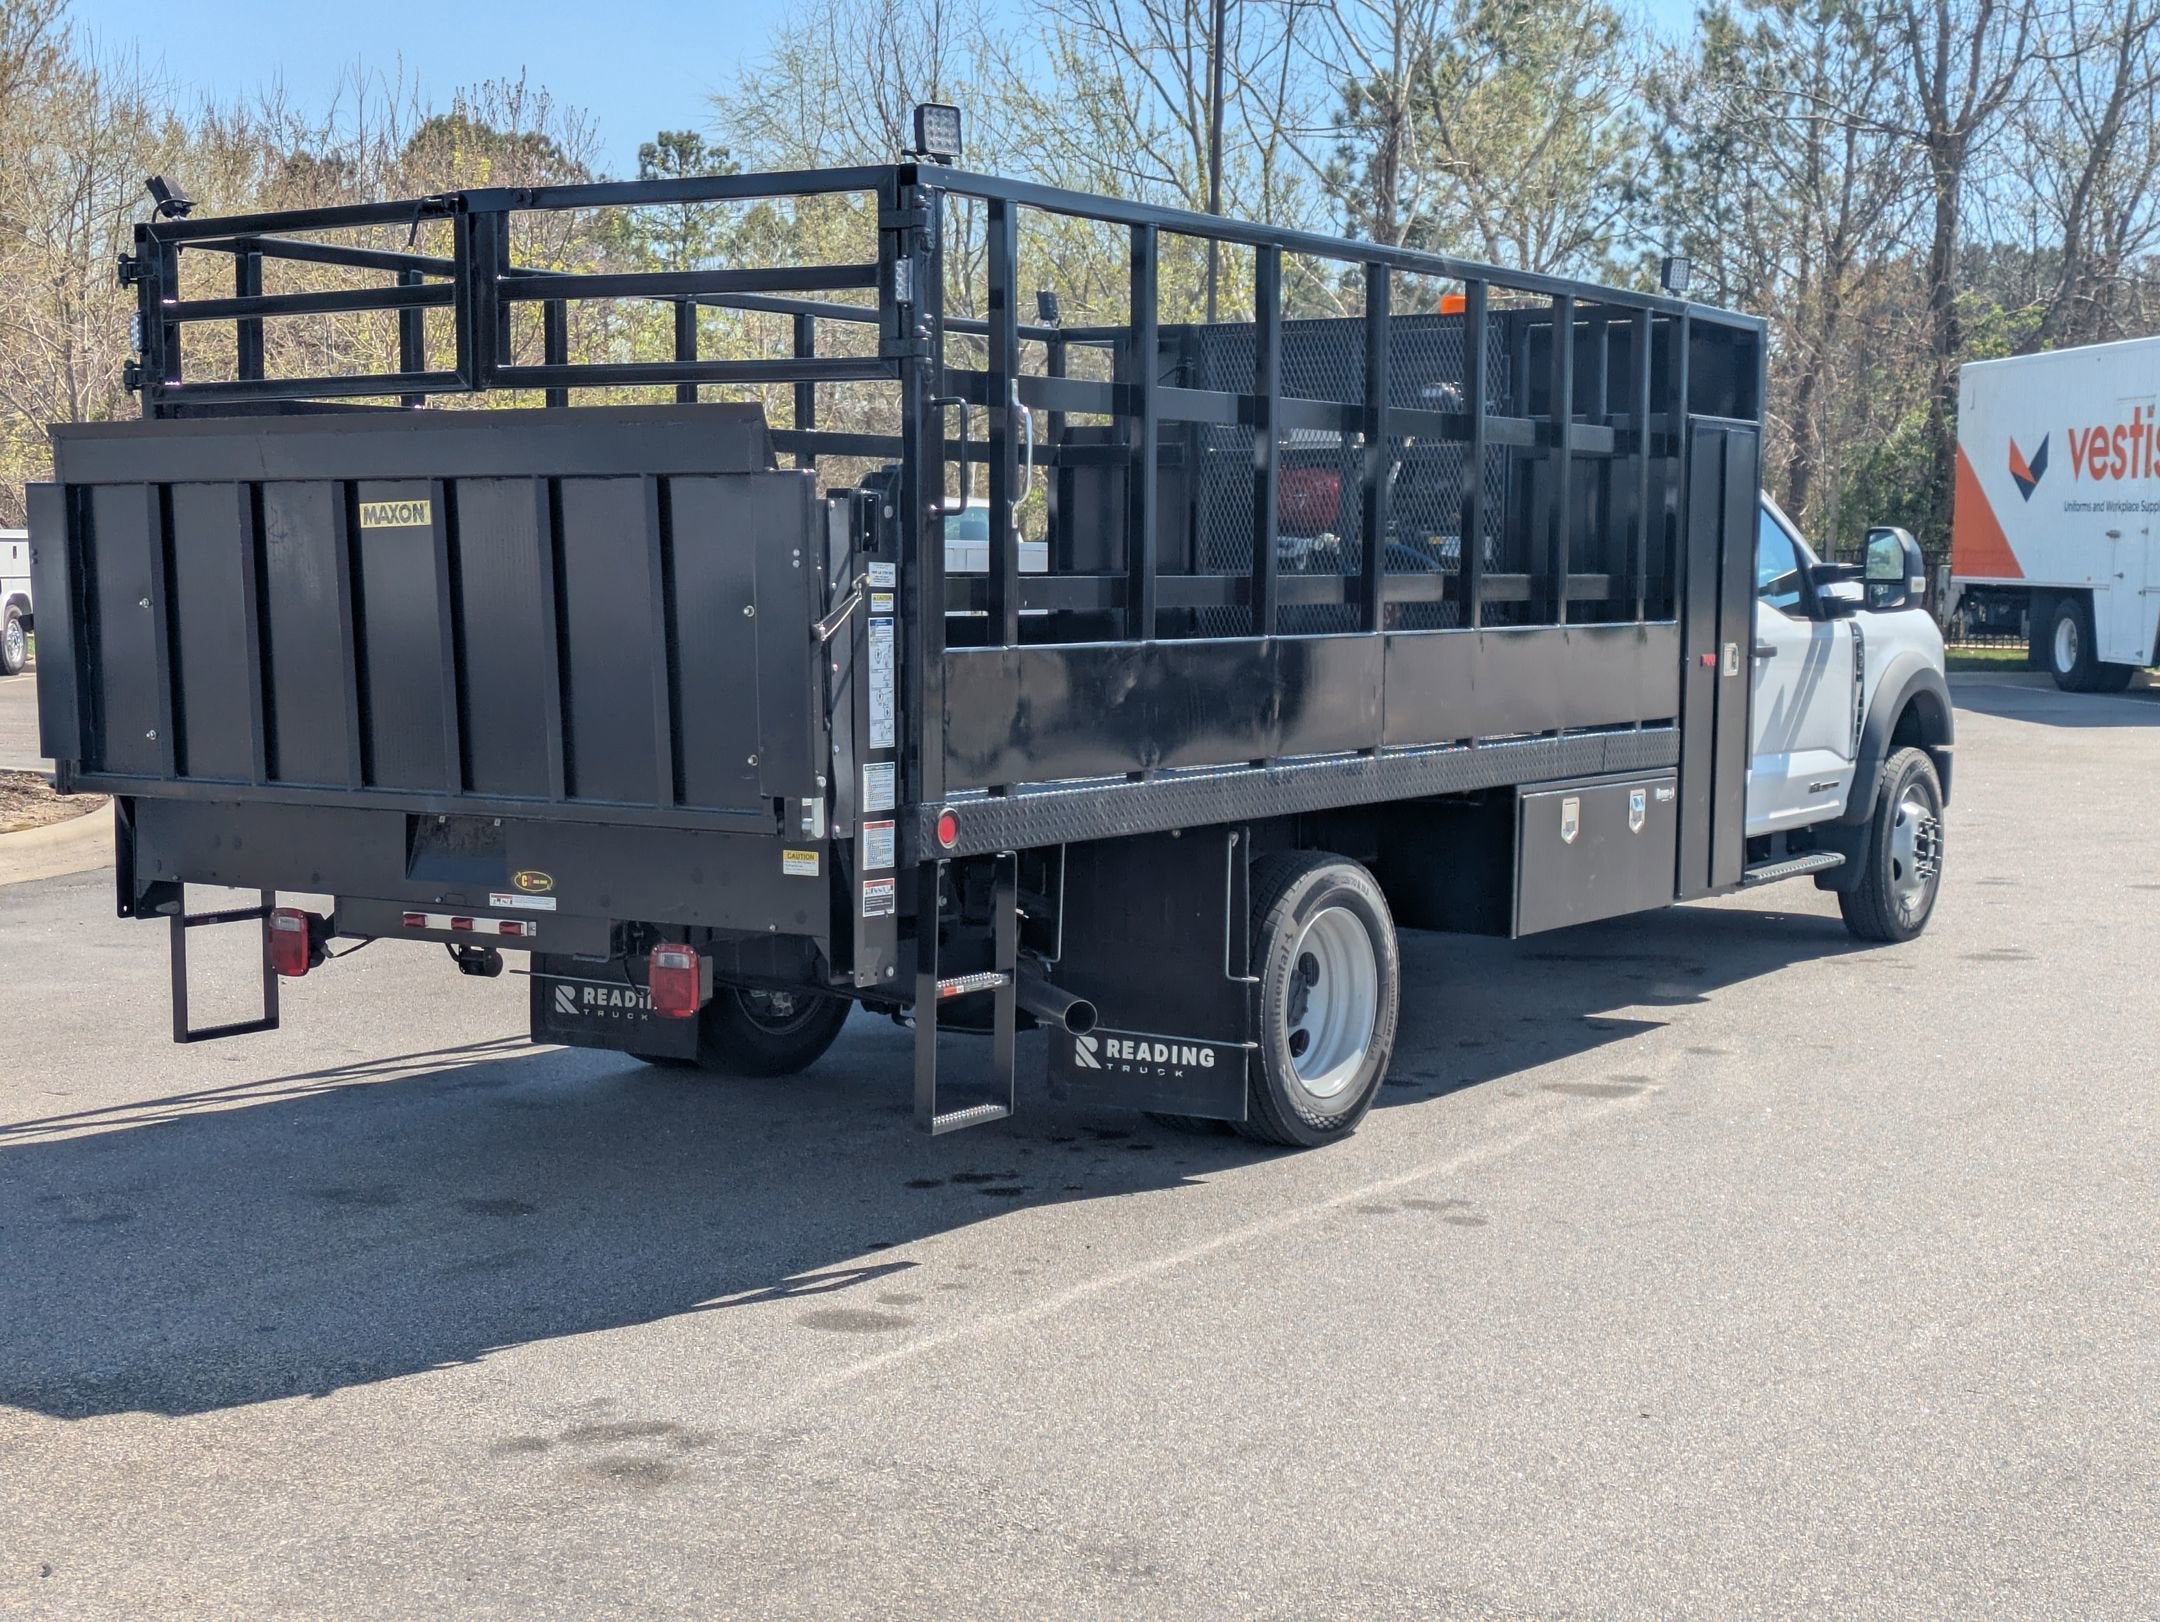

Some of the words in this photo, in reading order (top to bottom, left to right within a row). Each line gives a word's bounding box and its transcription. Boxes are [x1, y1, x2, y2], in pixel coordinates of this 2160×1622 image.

[363, 503, 425, 525] MAXON
[2093, 500, 2104, 512] and
[2141, 500, 2160, 514] Supp
[787, 852, 815, 860] CAUTION
[583, 987, 652, 1009] READI
[583, 1009, 648, 1021] TRUCK
[1106, 1039, 1215, 1068] READING
[1106, 1063, 1184, 1078] TRUCK
